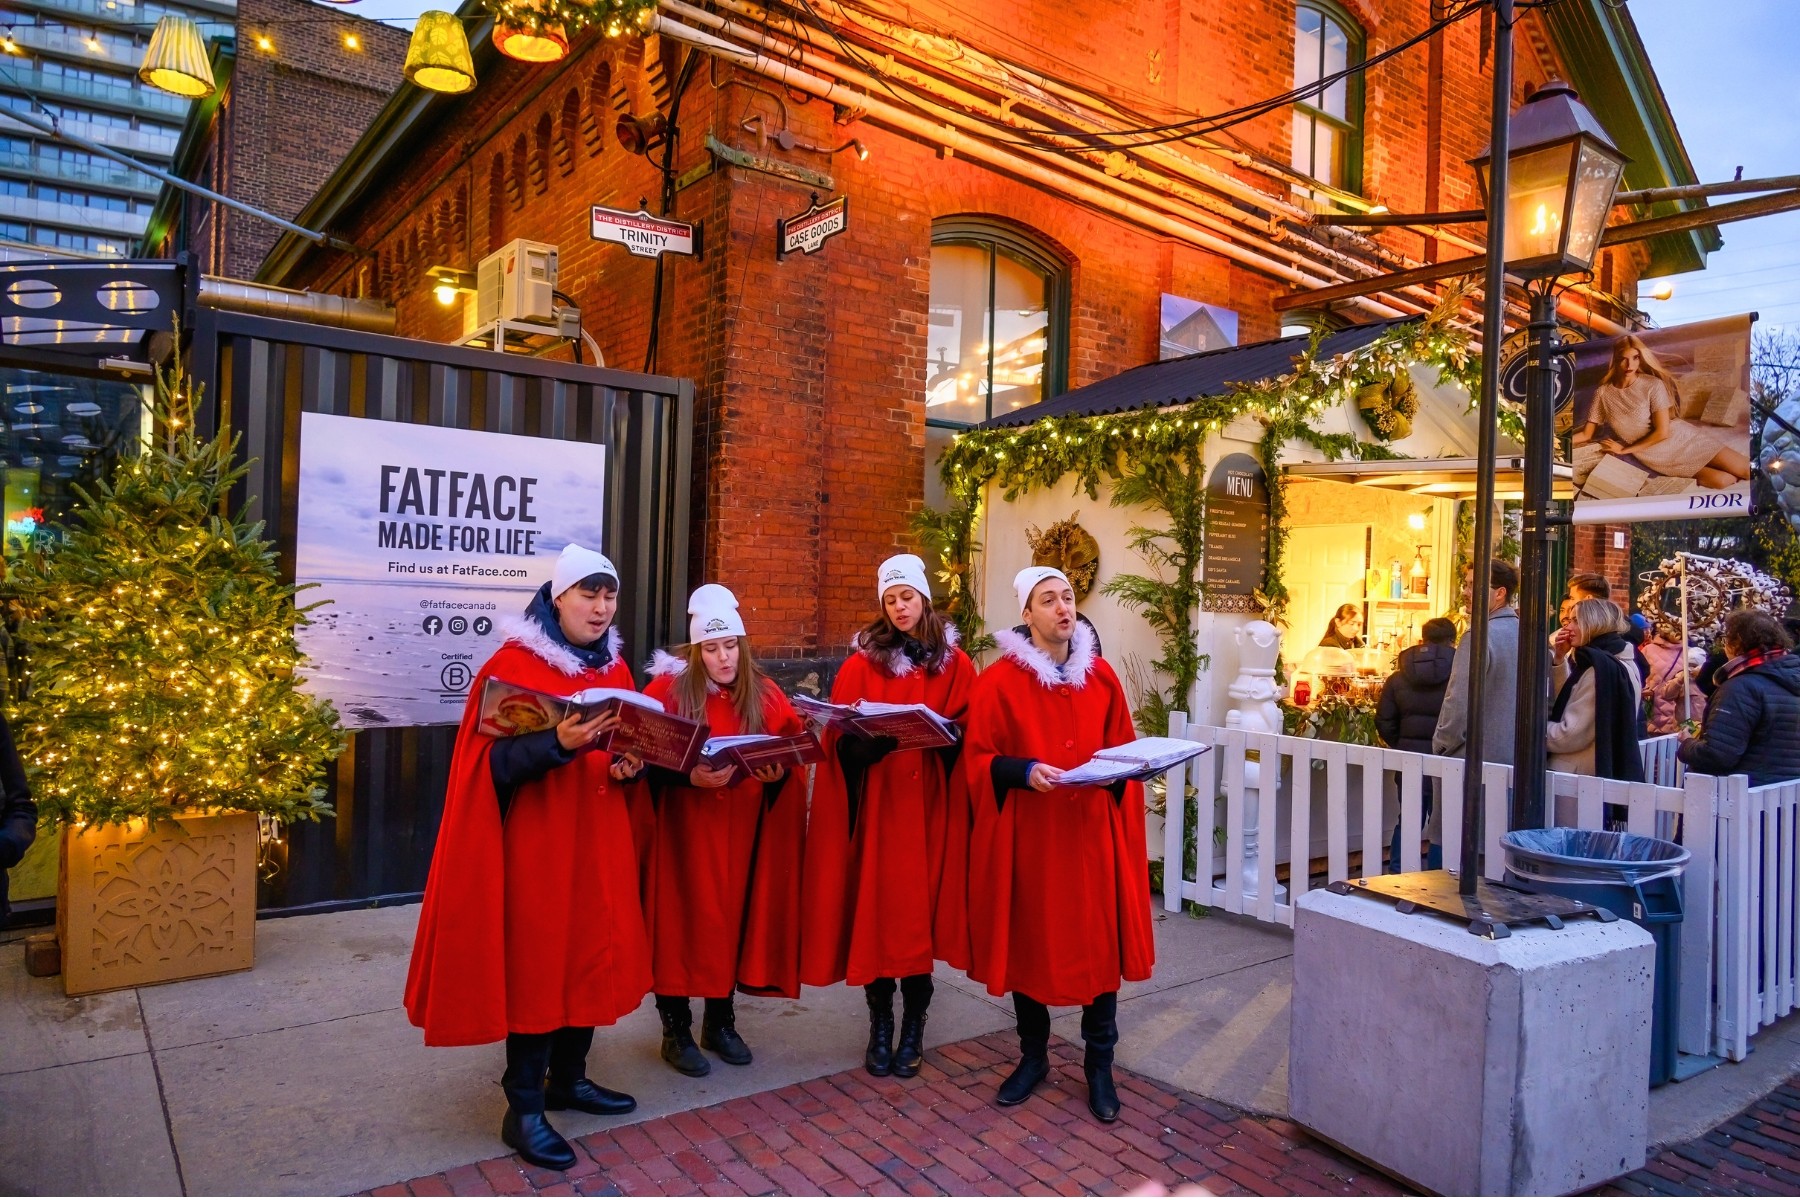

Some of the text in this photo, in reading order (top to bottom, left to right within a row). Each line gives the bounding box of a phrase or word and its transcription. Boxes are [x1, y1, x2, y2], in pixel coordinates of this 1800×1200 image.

[597, 214, 688, 236] THE DISTILLERY DISTRICT
[787, 226, 797, 234] THE
[796, 215, 821, 230] DISTILLERY
[820, 206, 842, 219] DISTRICT
[619, 228, 668, 247] TRINITY
[789, 217, 839, 248] CASE GOODS
[631, 245, 657, 254] STREET
[807, 240, 819, 250] LANE
[378, 464, 538, 523] FATFACE
[1226, 476, 1254, 498] MENU
[1688, 493, 1743, 510] DIOR
[378, 521, 443, 551] MADE
[449, 525, 490, 554] FOR
[387, 561, 527, 578] Find us at FatFace.com
[419, 599, 497, 611] @fatfacecanada
[449, 667, 464, 686] B
